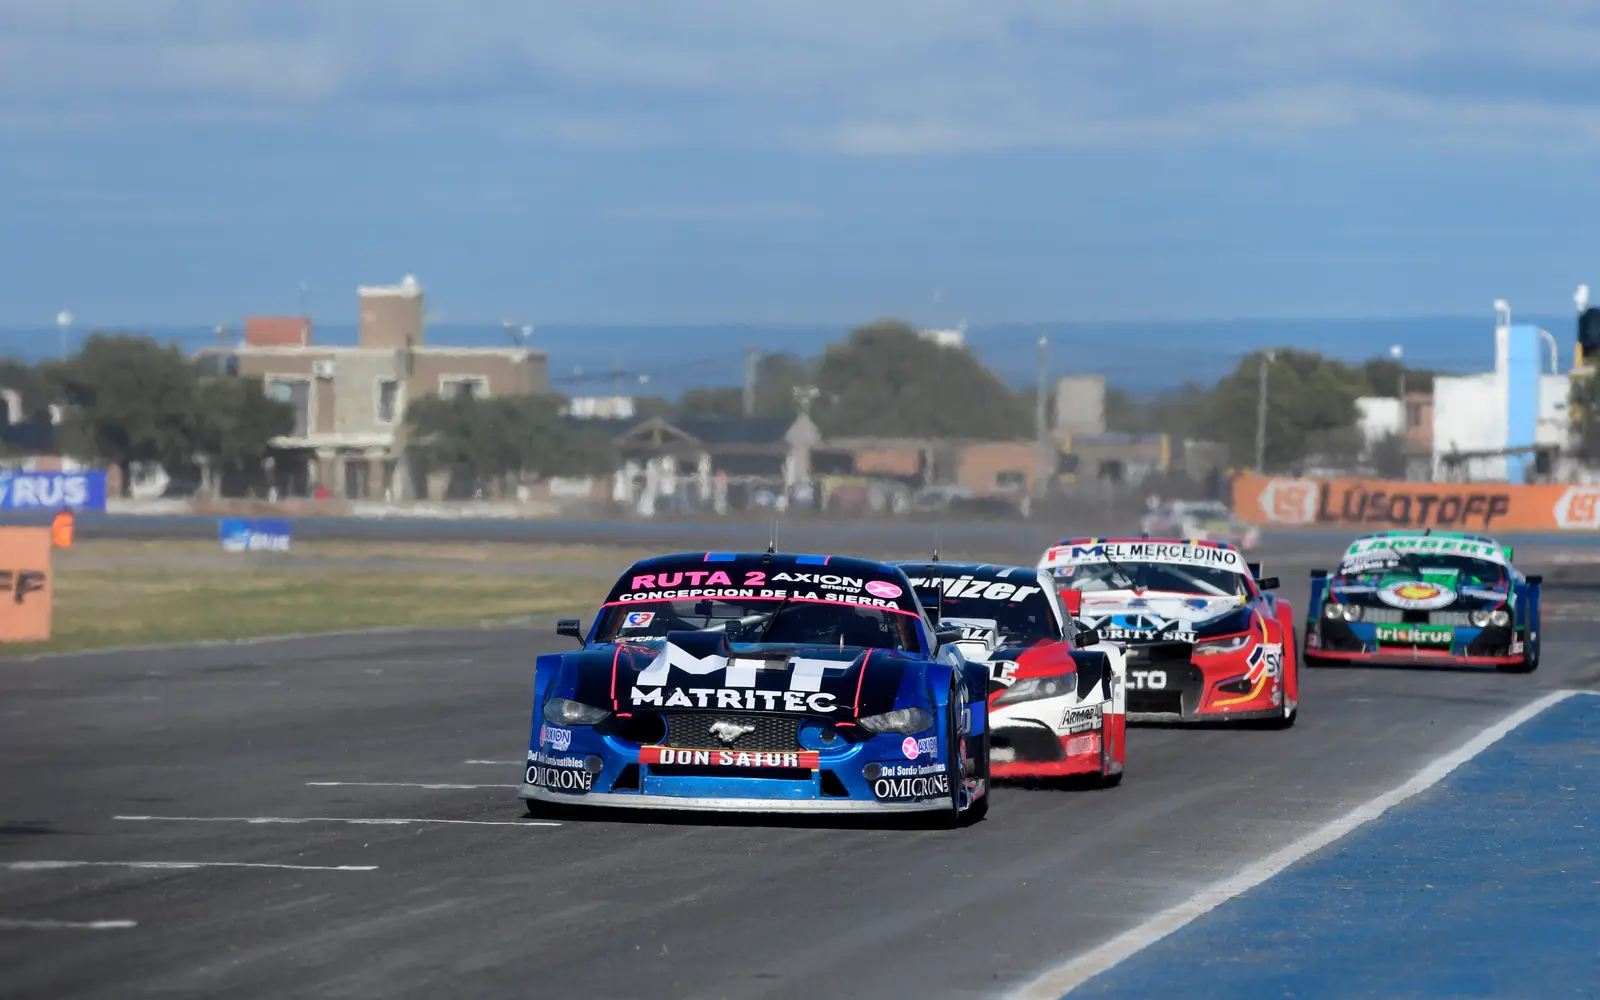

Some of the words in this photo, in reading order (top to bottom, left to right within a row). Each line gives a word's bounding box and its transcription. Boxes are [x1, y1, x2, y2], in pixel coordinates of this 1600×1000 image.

[12, 476, 88, 507] RUS
[1105, 544, 1126, 557] EL
[1130, 544, 1236, 565] MERCEDINO
[631, 571, 732, 590] RUTA
[743, 571, 767, 587] 2
[771, 572, 863, 588] AXION
[820, 583, 861, 594] energy
[619, 588, 754, 602] CONCEPCION
[760, 589, 787, 598] DE
[793, 590, 819, 600] LA
[825, 593, 900, 611] SIERRA
[1098, 629, 1159, 640] URITY
[1163, 632, 1200, 645] SRL
[630, 686, 838, 713] MATRITEC
[527, 749, 538, 762] Del
[660, 749, 709, 765] DON
[719, 750, 798, 767] SATUR
[526, 765, 586, 789] OMICRON
[882, 766, 895, 777] Del
[897, 764, 917, 776] Sordo
[875, 774, 944, 798] OMICRON
